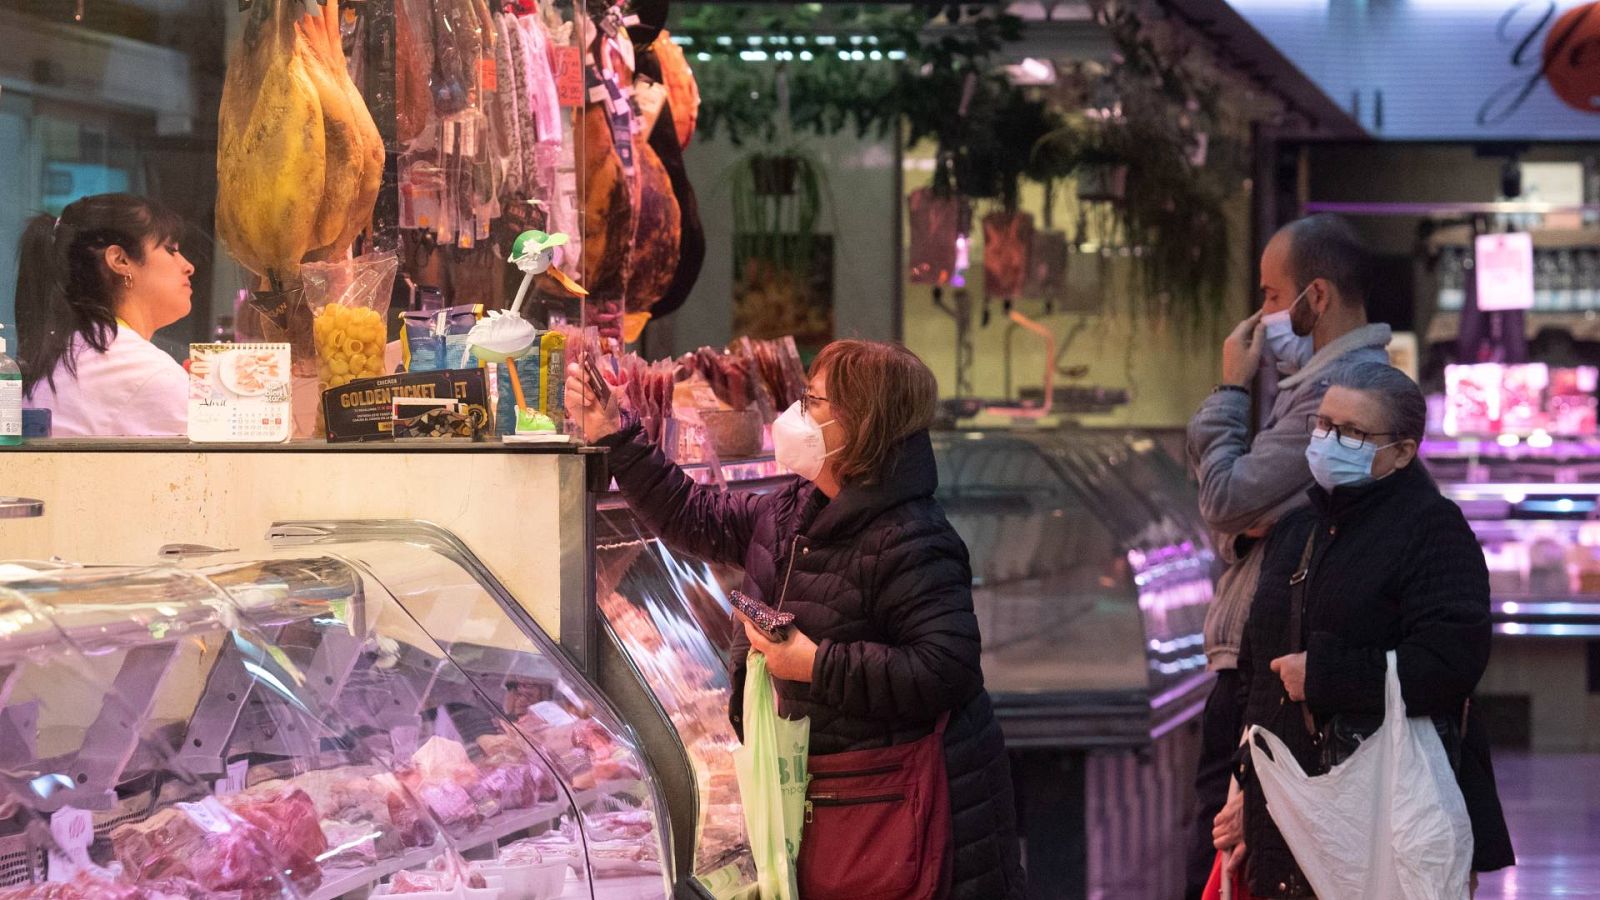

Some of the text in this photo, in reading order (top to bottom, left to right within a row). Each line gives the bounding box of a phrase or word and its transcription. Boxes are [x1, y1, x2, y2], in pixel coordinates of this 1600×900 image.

[340, 383, 436, 408] GOLDEN TICKET
[454, 381, 468, 399] ET
[199, 398, 227, 408] Abril
